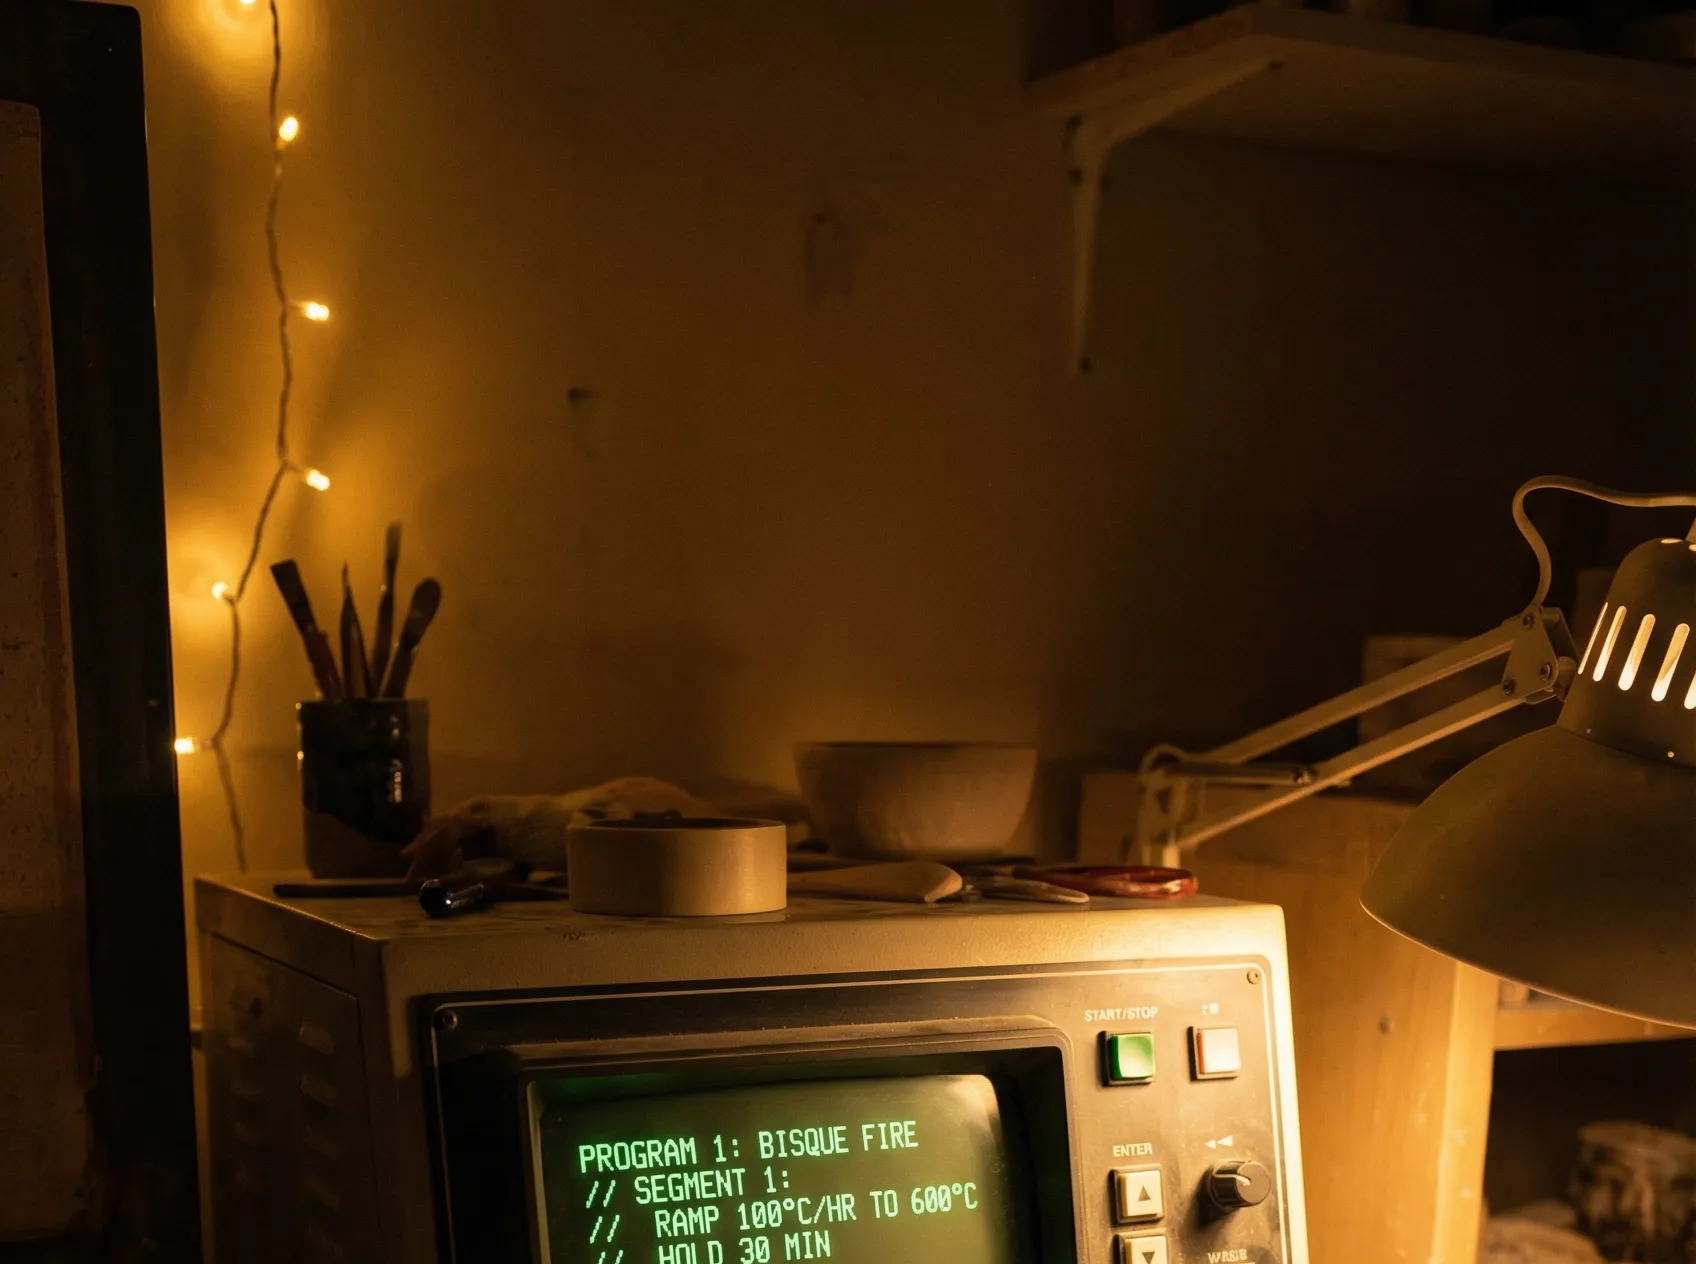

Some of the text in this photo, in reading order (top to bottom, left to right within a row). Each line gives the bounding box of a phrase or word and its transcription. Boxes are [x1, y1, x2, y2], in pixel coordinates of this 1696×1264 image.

[1083, 1006, 1159, 1022] START/STOP
[578, 1120, 919, 1174] PROGRAM 1: BISQUE FIRE
[1112, 1142, 1154, 1158] ENTER
[585, 1167, 791, 1209] // SEGMENT 1:
[588, 1182, 978, 1244] // RAMP 100°C/HR TO 600°C
[784, 1229, 832, 1261] MIN
